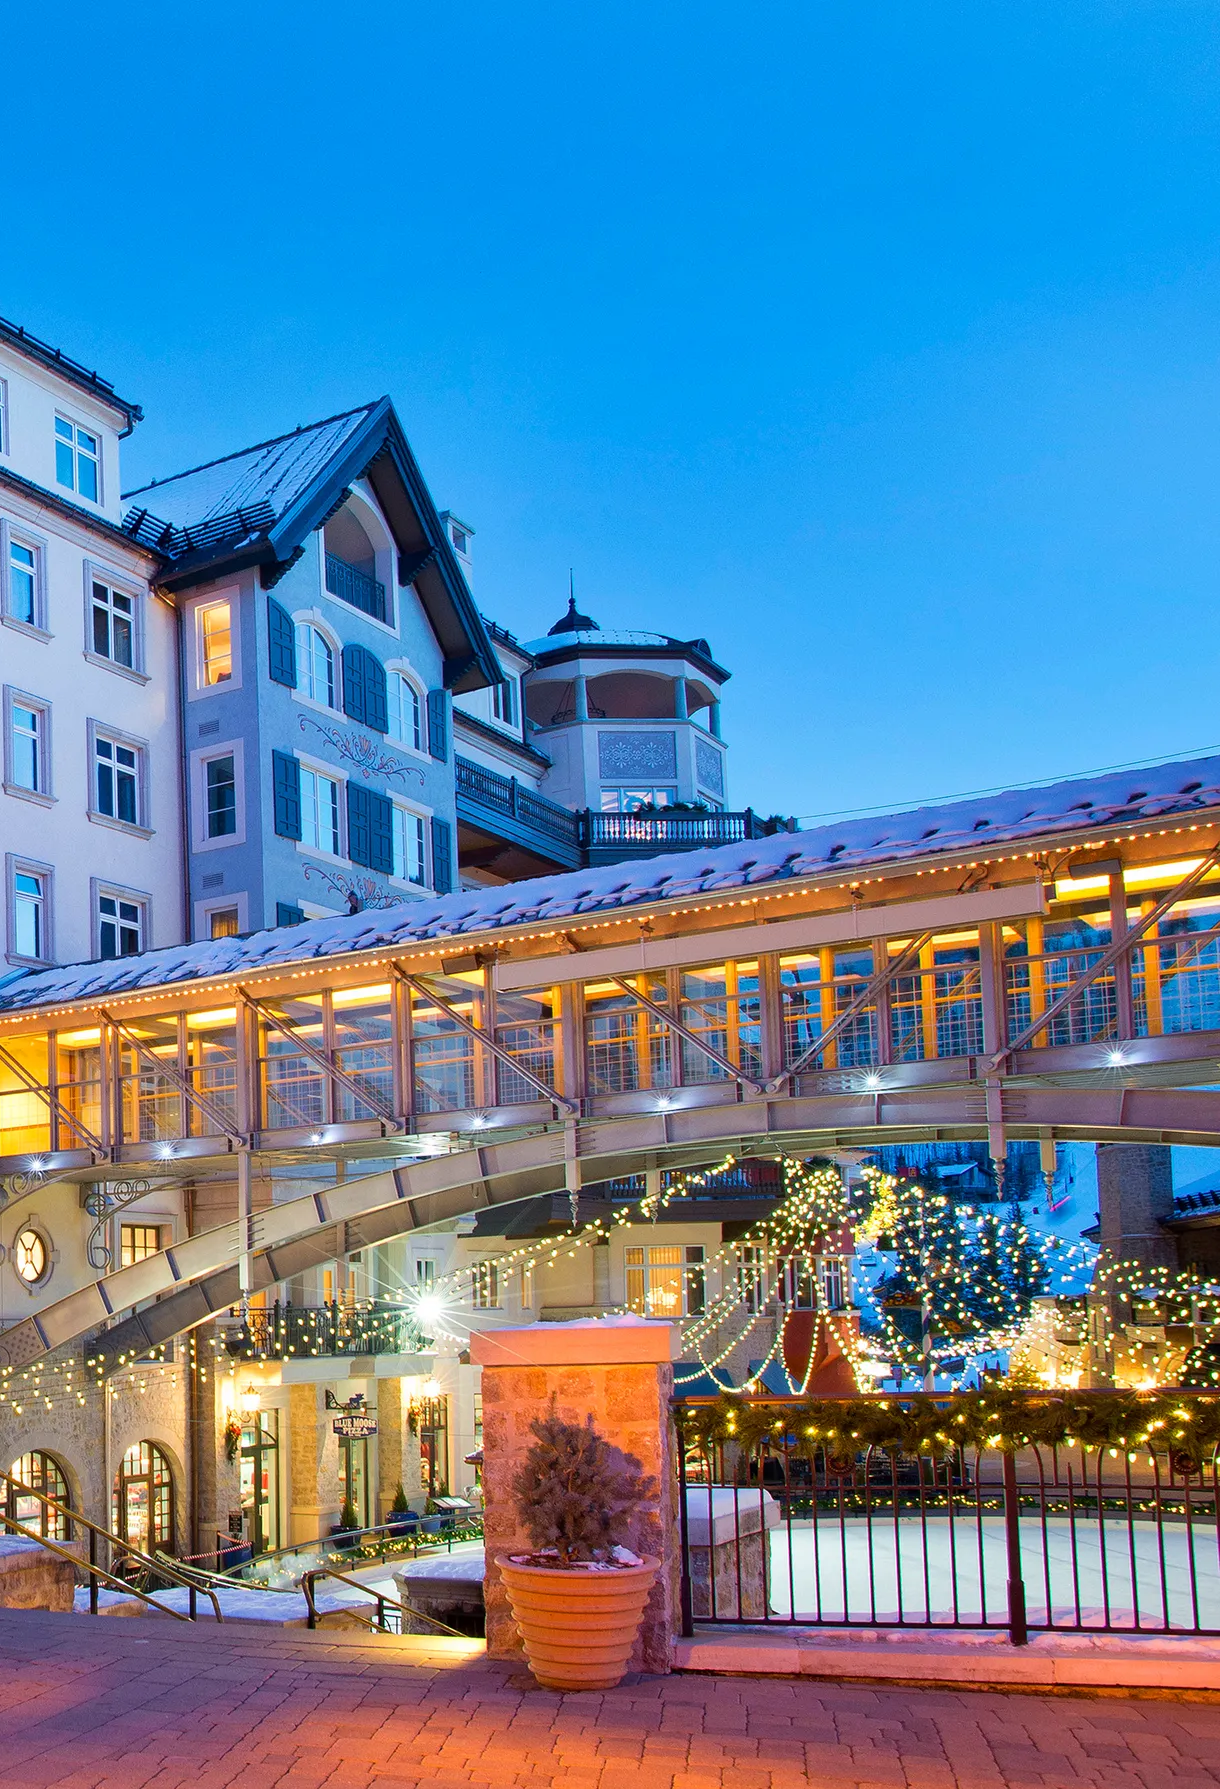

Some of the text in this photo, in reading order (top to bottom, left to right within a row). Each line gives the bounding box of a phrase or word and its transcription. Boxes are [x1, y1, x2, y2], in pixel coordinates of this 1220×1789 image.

[334, 1417, 377, 1428] BLUE MOOSE
[343, 1427, 369, 1435] PIZZA
